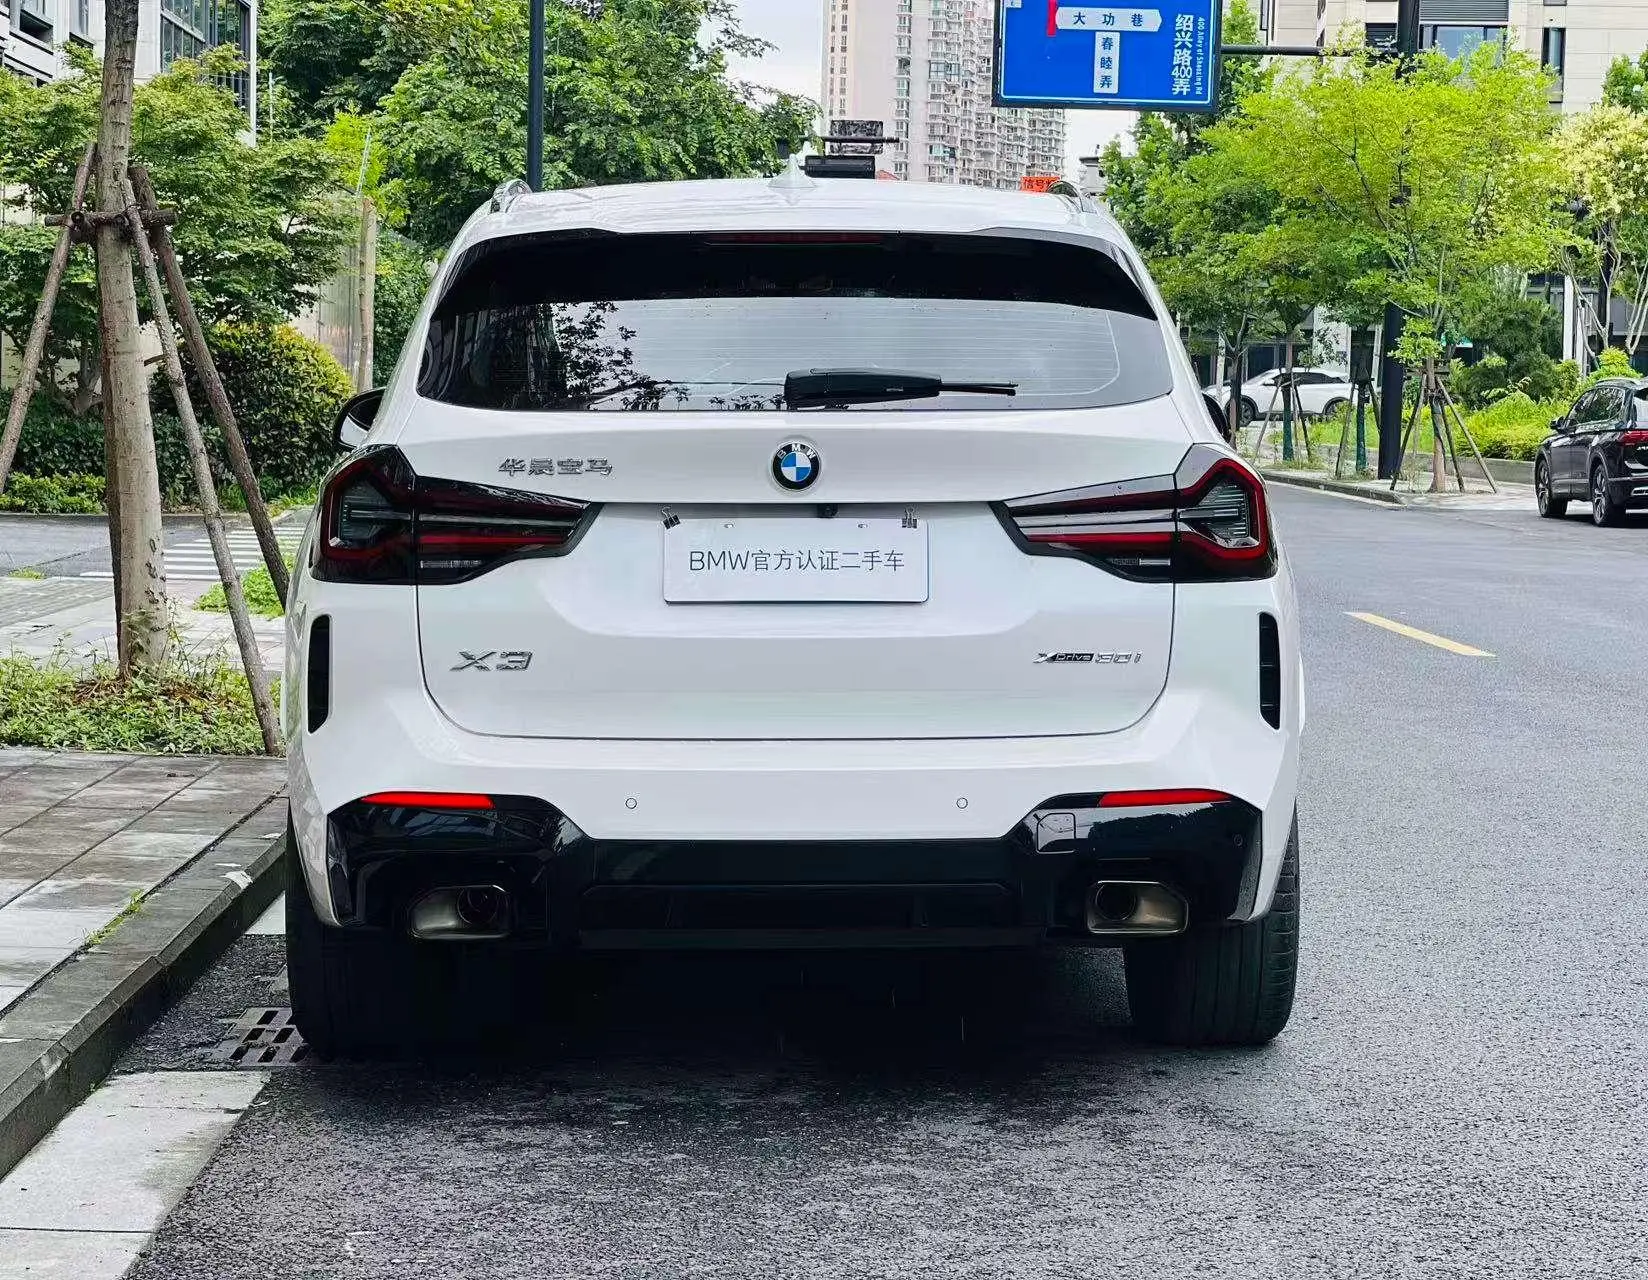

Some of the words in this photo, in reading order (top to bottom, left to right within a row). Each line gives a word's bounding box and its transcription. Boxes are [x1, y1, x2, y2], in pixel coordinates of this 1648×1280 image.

[1073, 12, 1144, 27] 大功巷
[1197, 16, 1206, 30] 400
[1100, 37, 1114, 89] 春睦弄
[1172, 14, 1194, 96] 绍兴路400弄
[498, 457, 614, 477] 华晨宝马
[689, 550, 905, 572] BMW官方认证二手车
[449, 651, 533, 672] X3
